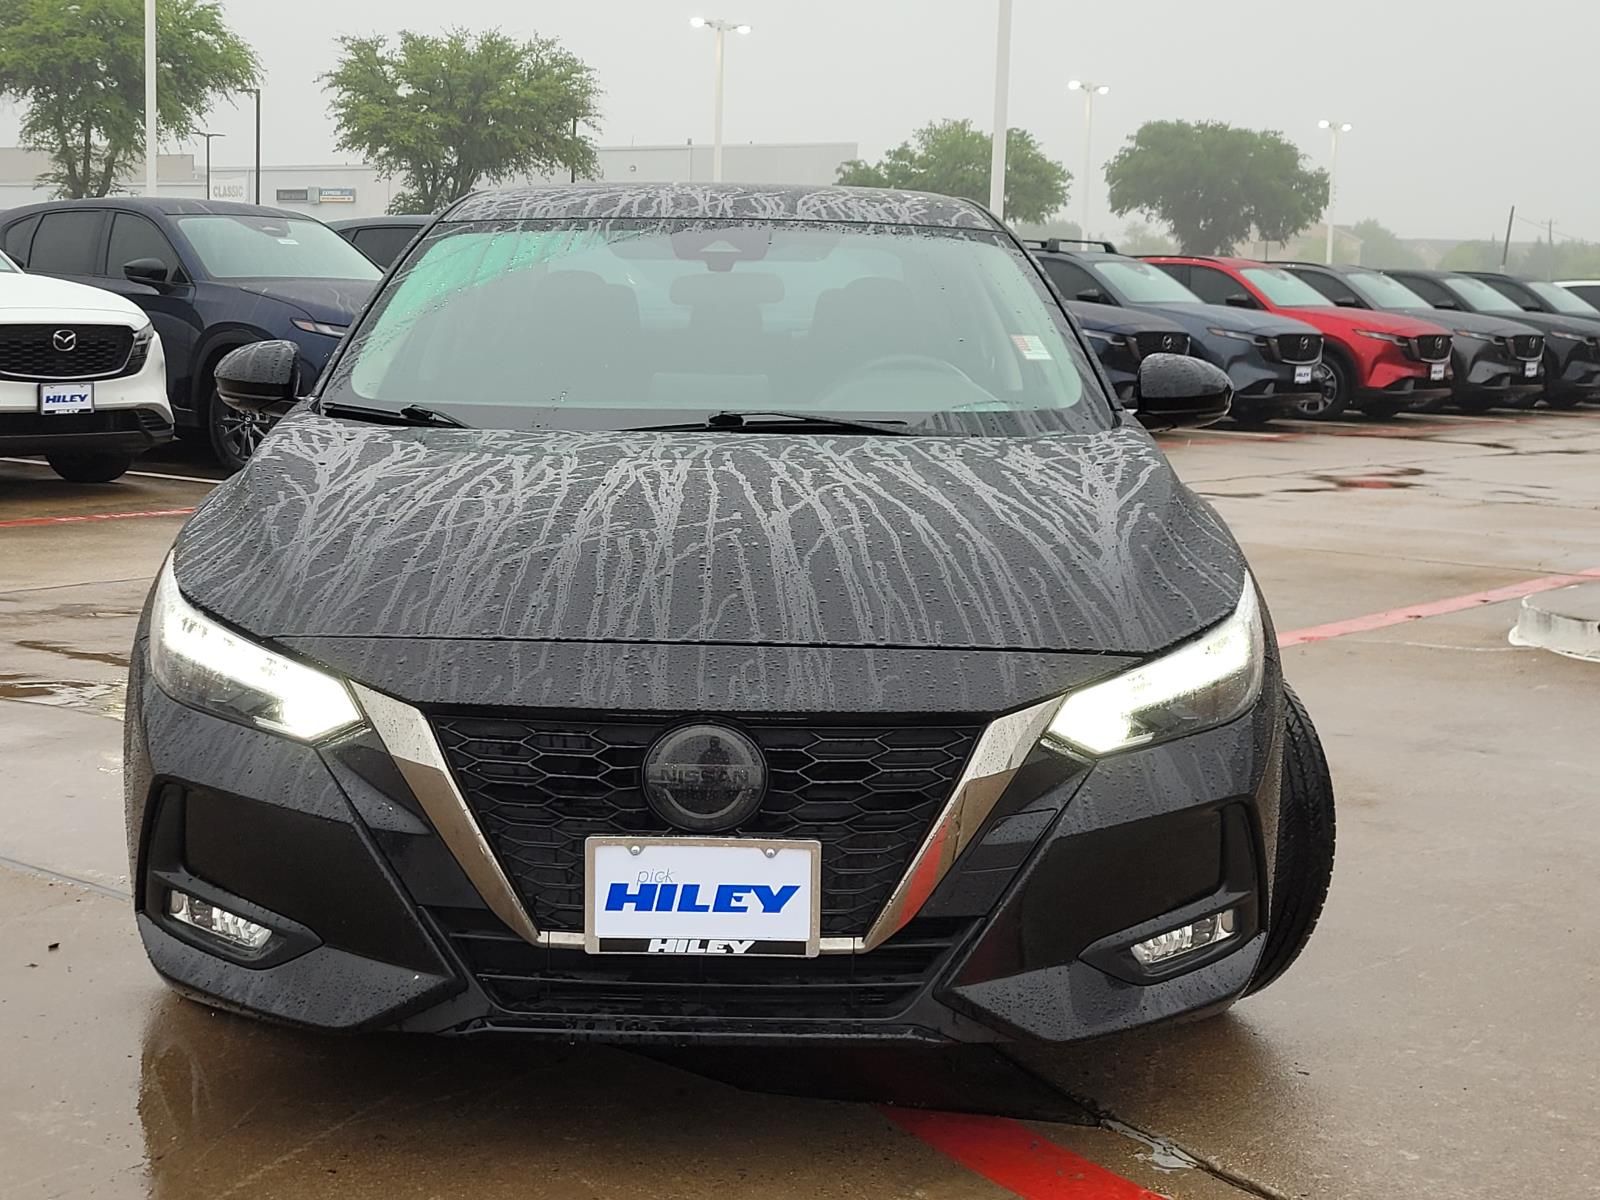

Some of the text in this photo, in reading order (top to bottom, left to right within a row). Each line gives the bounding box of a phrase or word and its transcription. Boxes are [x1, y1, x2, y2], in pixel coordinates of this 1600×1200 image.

[212, 184, 244, 198] CLASSIC
[45, 394, 88, 403] HILEY
[660, 767, 750, 785] NISSAN
[636, 867, 677, 886] pick
[605, 882, 800, 913] HILEY
[647, 938, 756, 954] HILEY
